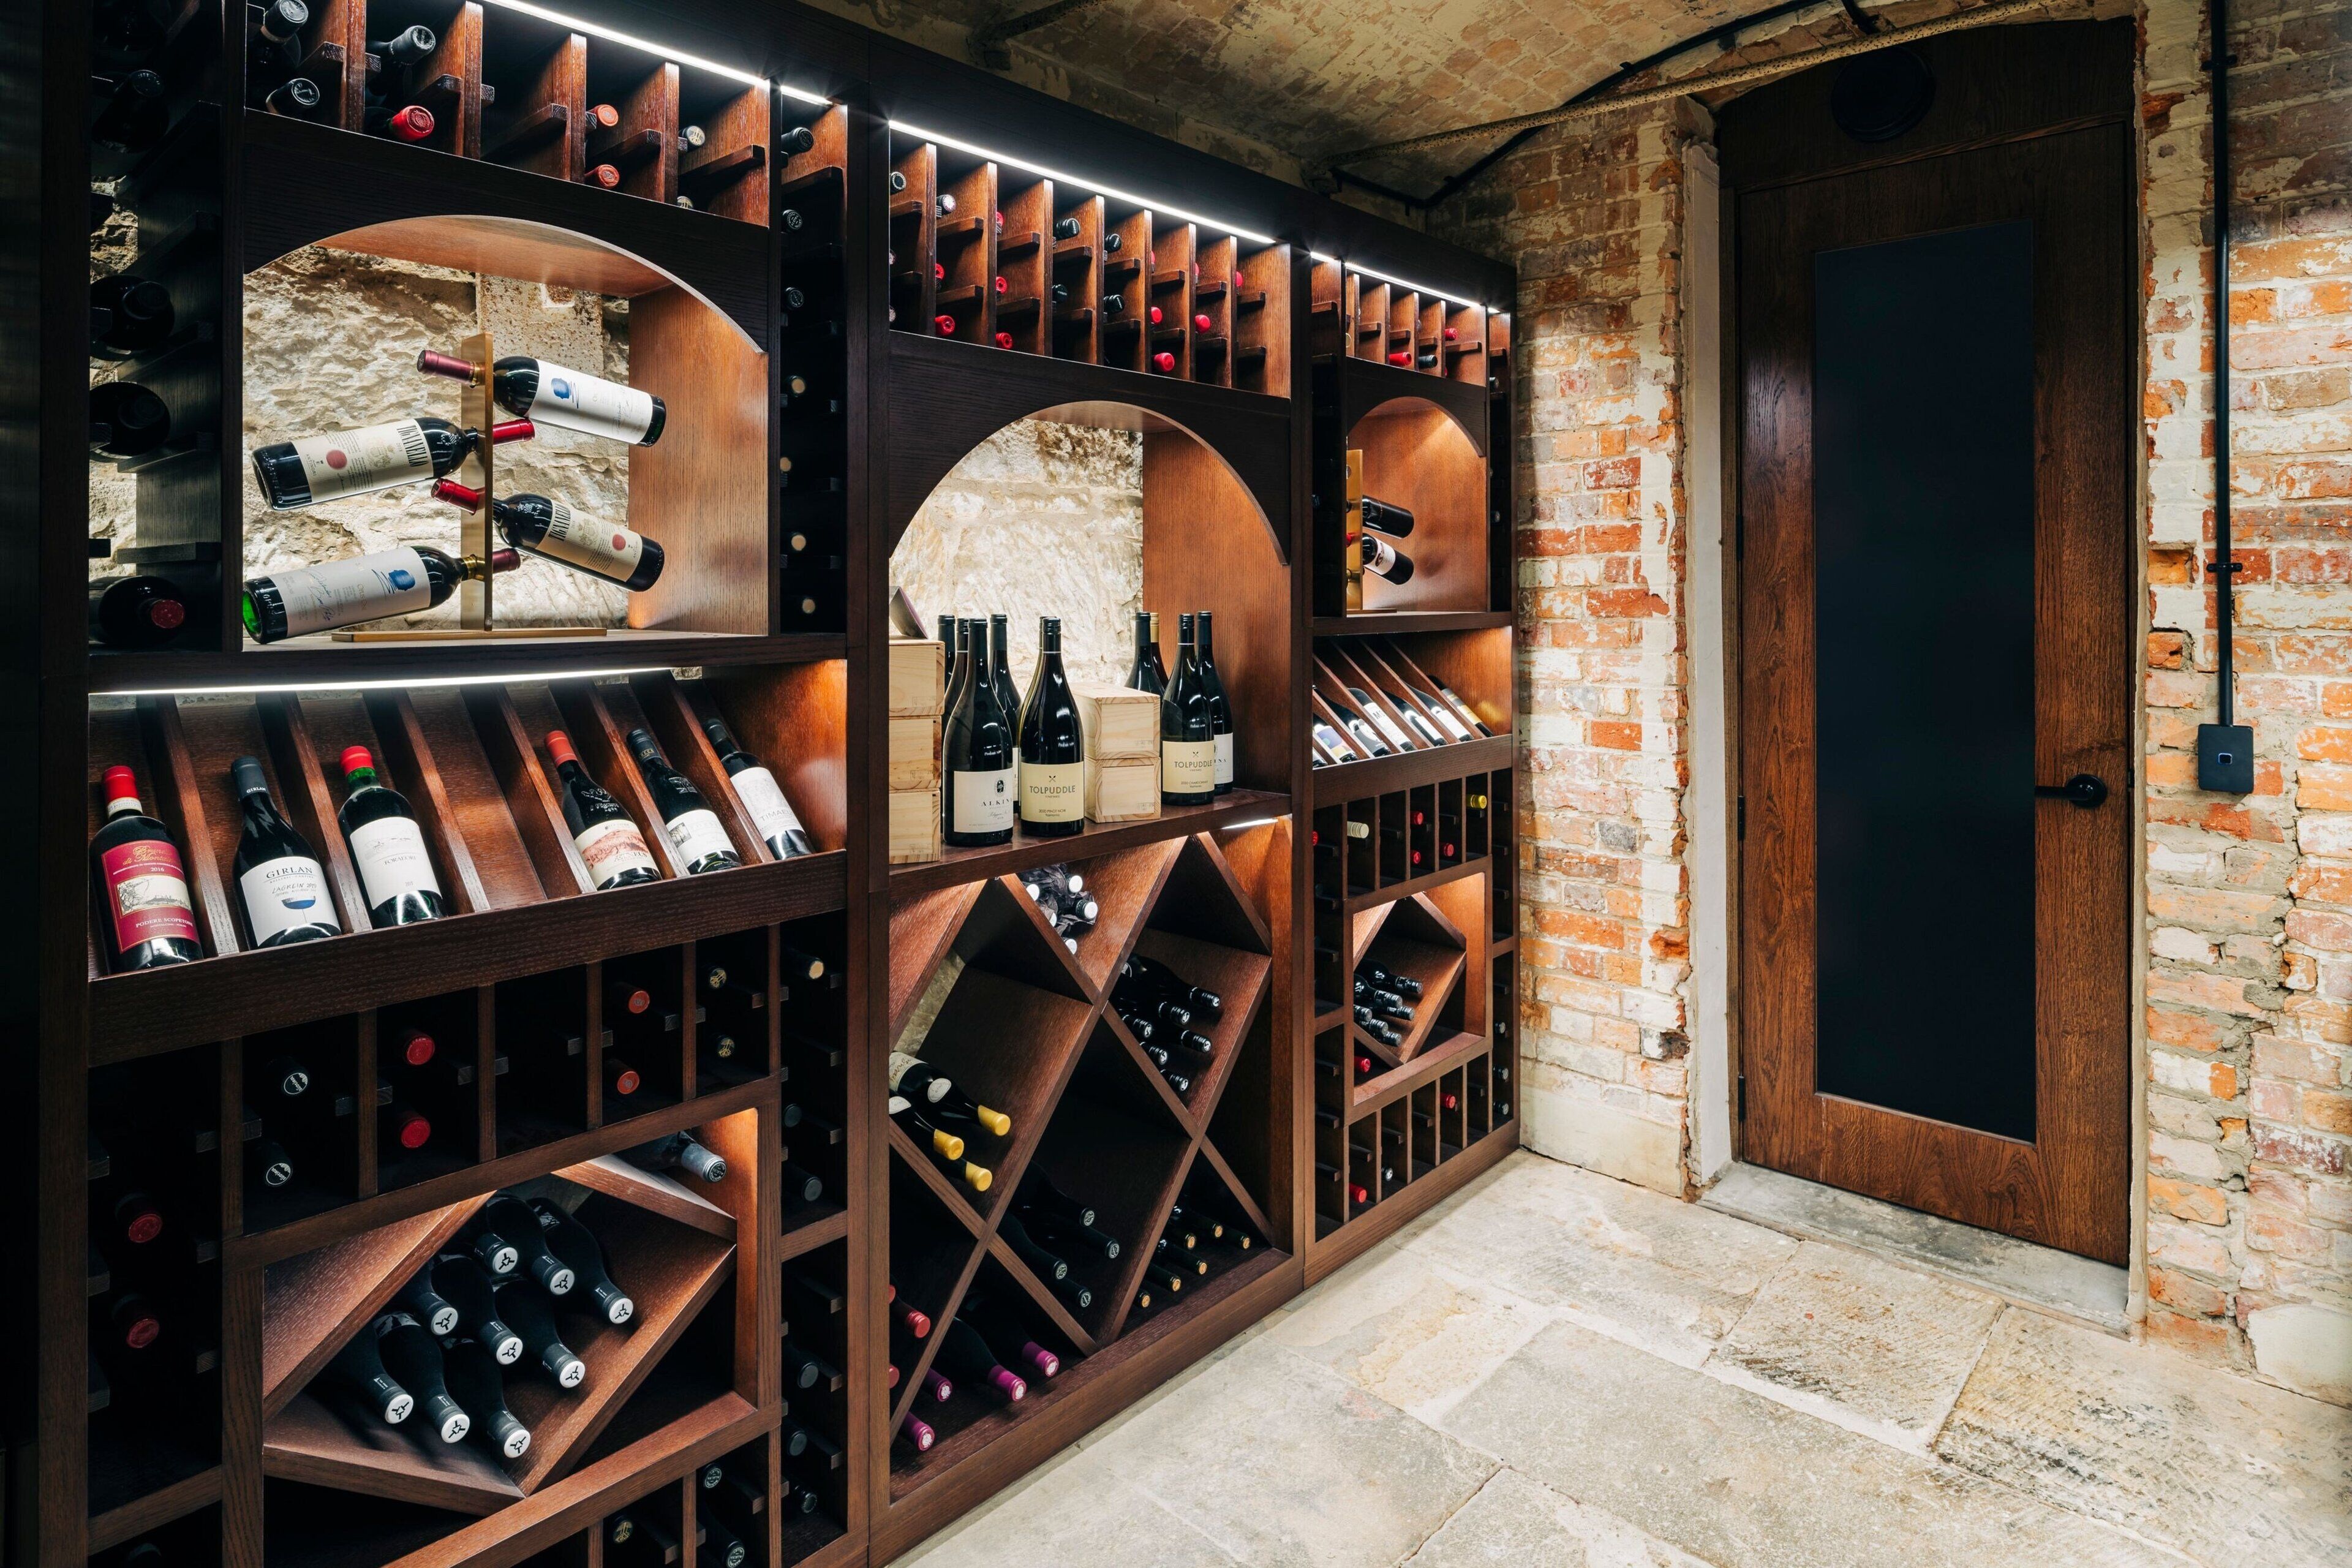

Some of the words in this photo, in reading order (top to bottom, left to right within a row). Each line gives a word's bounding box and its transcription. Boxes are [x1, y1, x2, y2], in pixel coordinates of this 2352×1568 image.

[396, 424, 429, 467] TIGNANELLO
[306, 453, 317, 477] ANTINORI
[548, 503, 571, 541] TIGNANELL
[1174, 760, 1213, 769] TOLPUDDLE
[1029, 785, 1076, 794] TOLPUDDLE
[981, 798, 1012, 807] ALKIN
[266, 866, 312, 879] GIRLAN
[135, 918, 163, 928] PODERE
